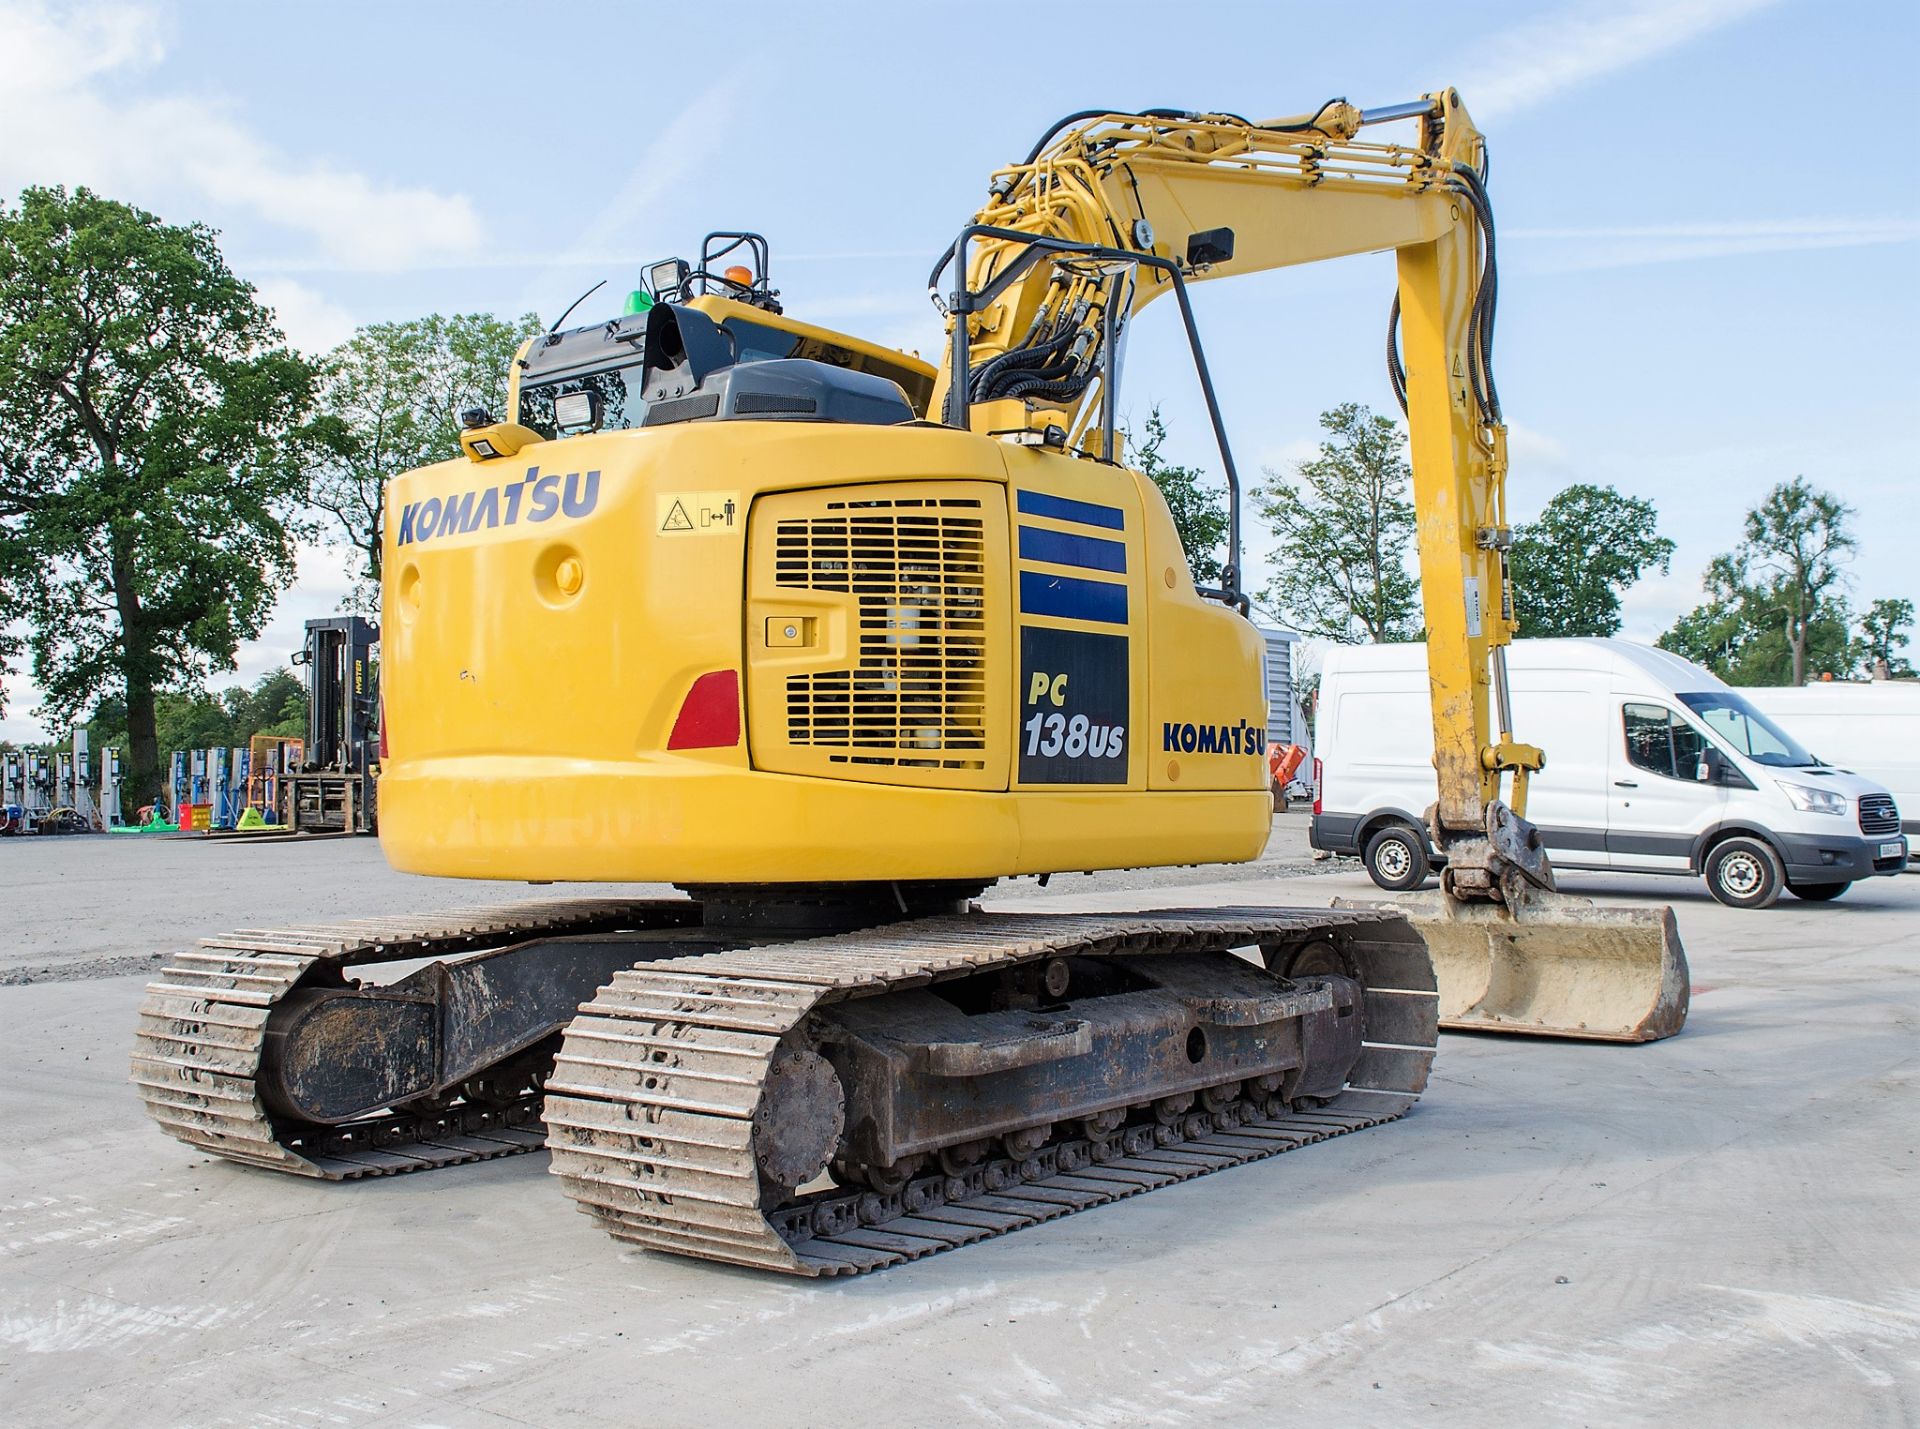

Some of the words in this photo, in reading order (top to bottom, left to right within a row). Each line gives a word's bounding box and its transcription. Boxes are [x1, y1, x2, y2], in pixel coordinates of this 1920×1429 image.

[399, 467, 601, 546] KOMATSU
[354, 659, 363, 695] HYSTER
[1028, 672, 1068, 707] PC
[1025, 712, 1125, 759] 138US
[1163, 718, 1266, 756] KOMATSU
